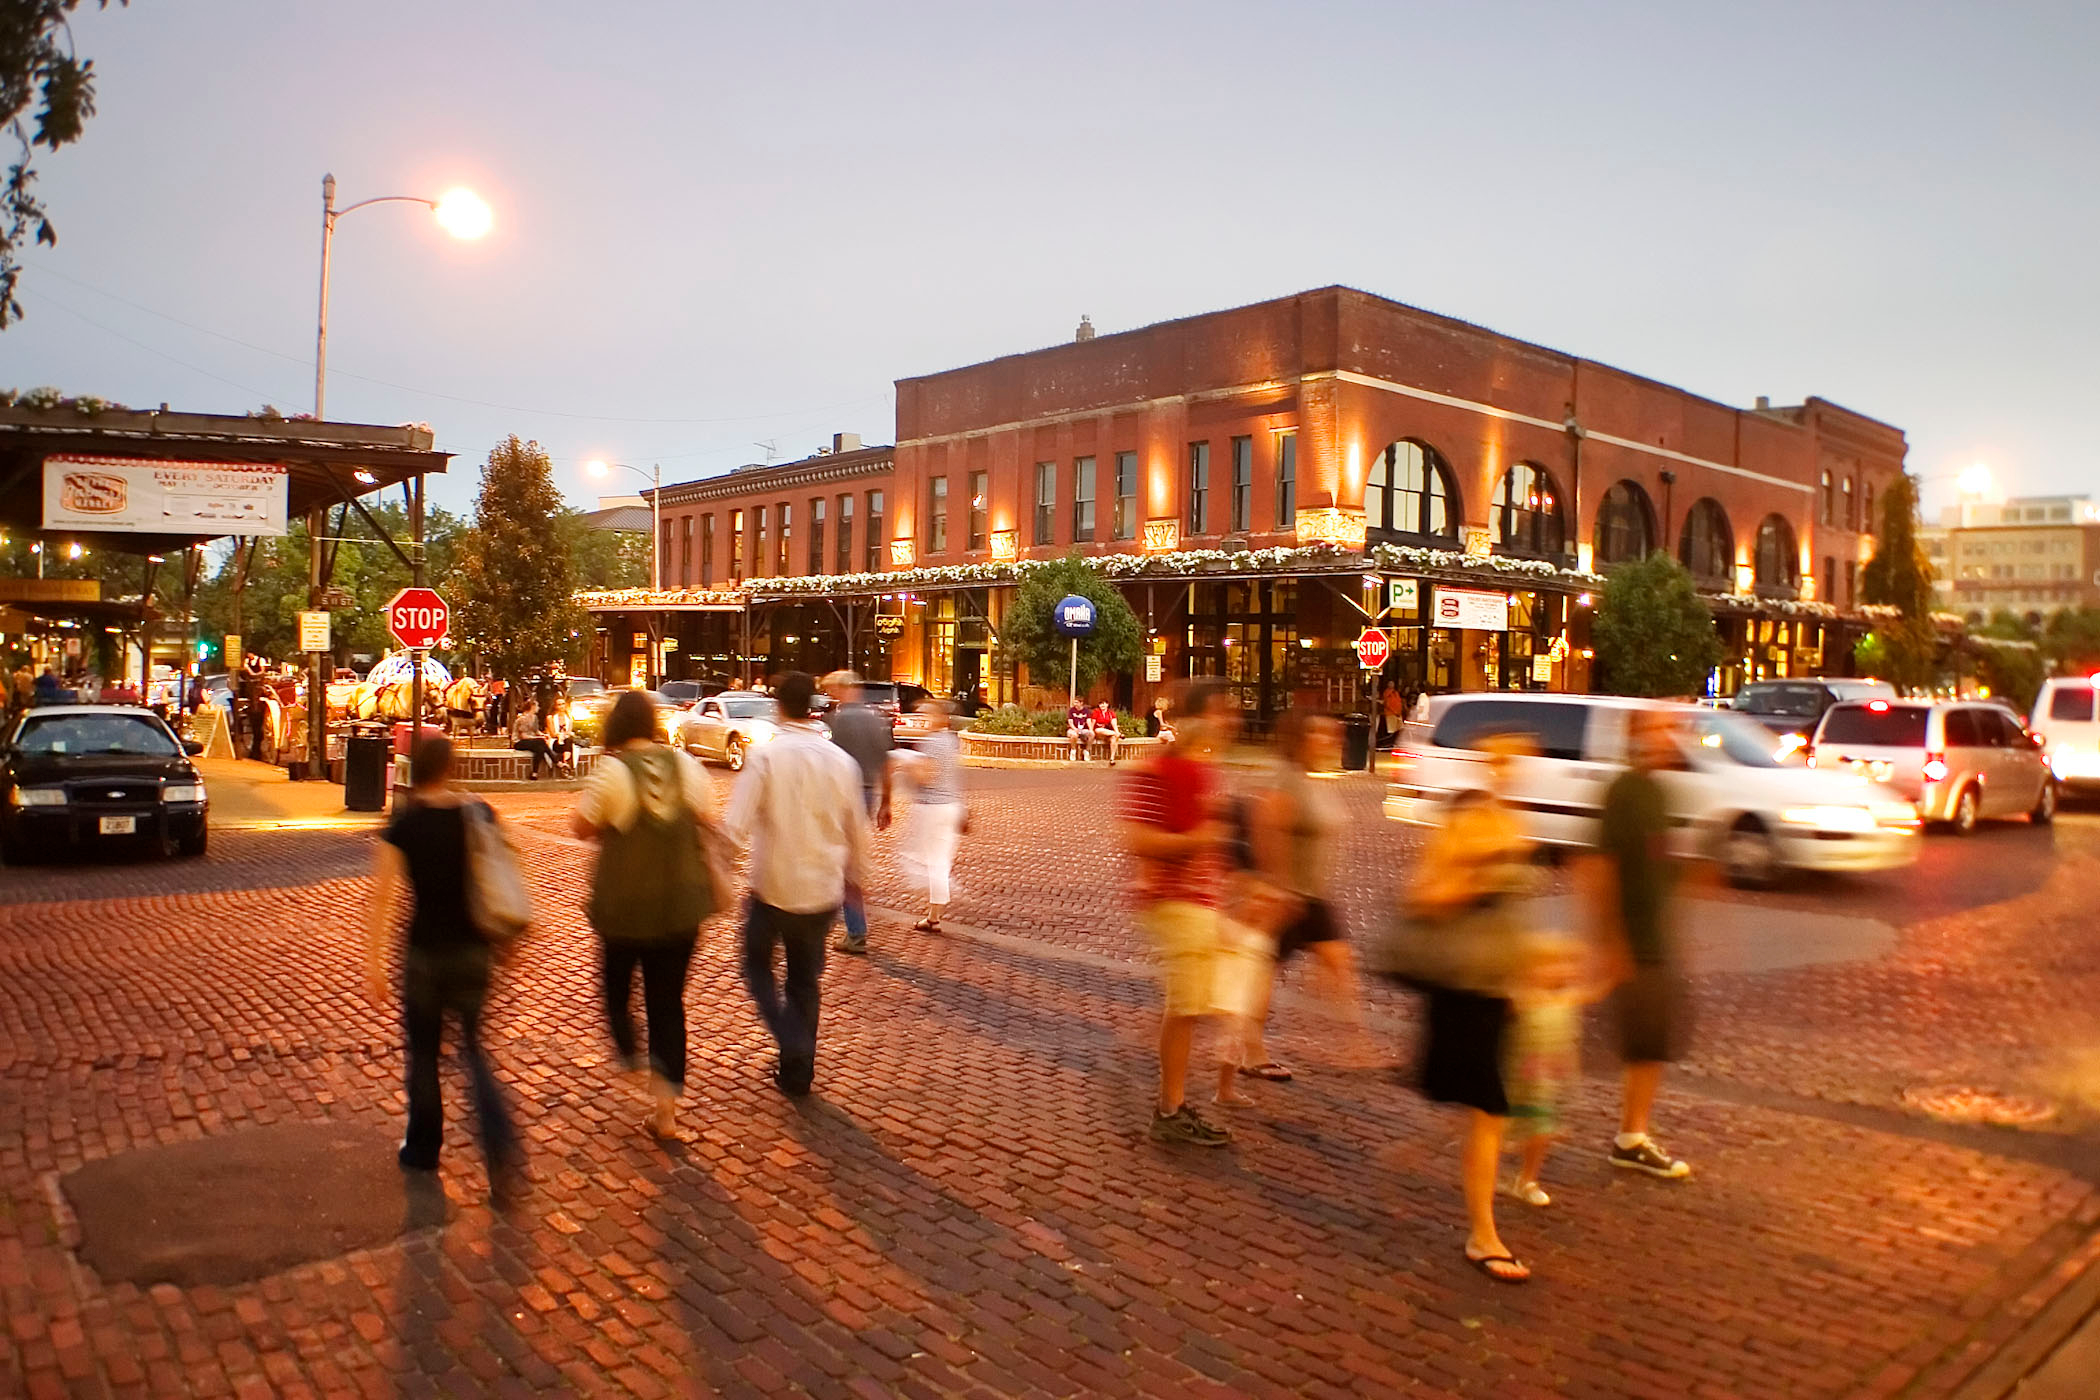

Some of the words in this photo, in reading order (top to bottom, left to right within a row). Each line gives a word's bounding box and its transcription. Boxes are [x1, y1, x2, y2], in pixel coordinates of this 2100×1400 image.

[154, 472, 198, 481] EVERY
[205, 474, 276, 484] SATURDAY
[1392, 584, 1404, 602] P
[394, 607, 445, 629] STOP
[1064, 604, 1091, 621] OMAHA
[1360, 641, 1386, 655] STOP
